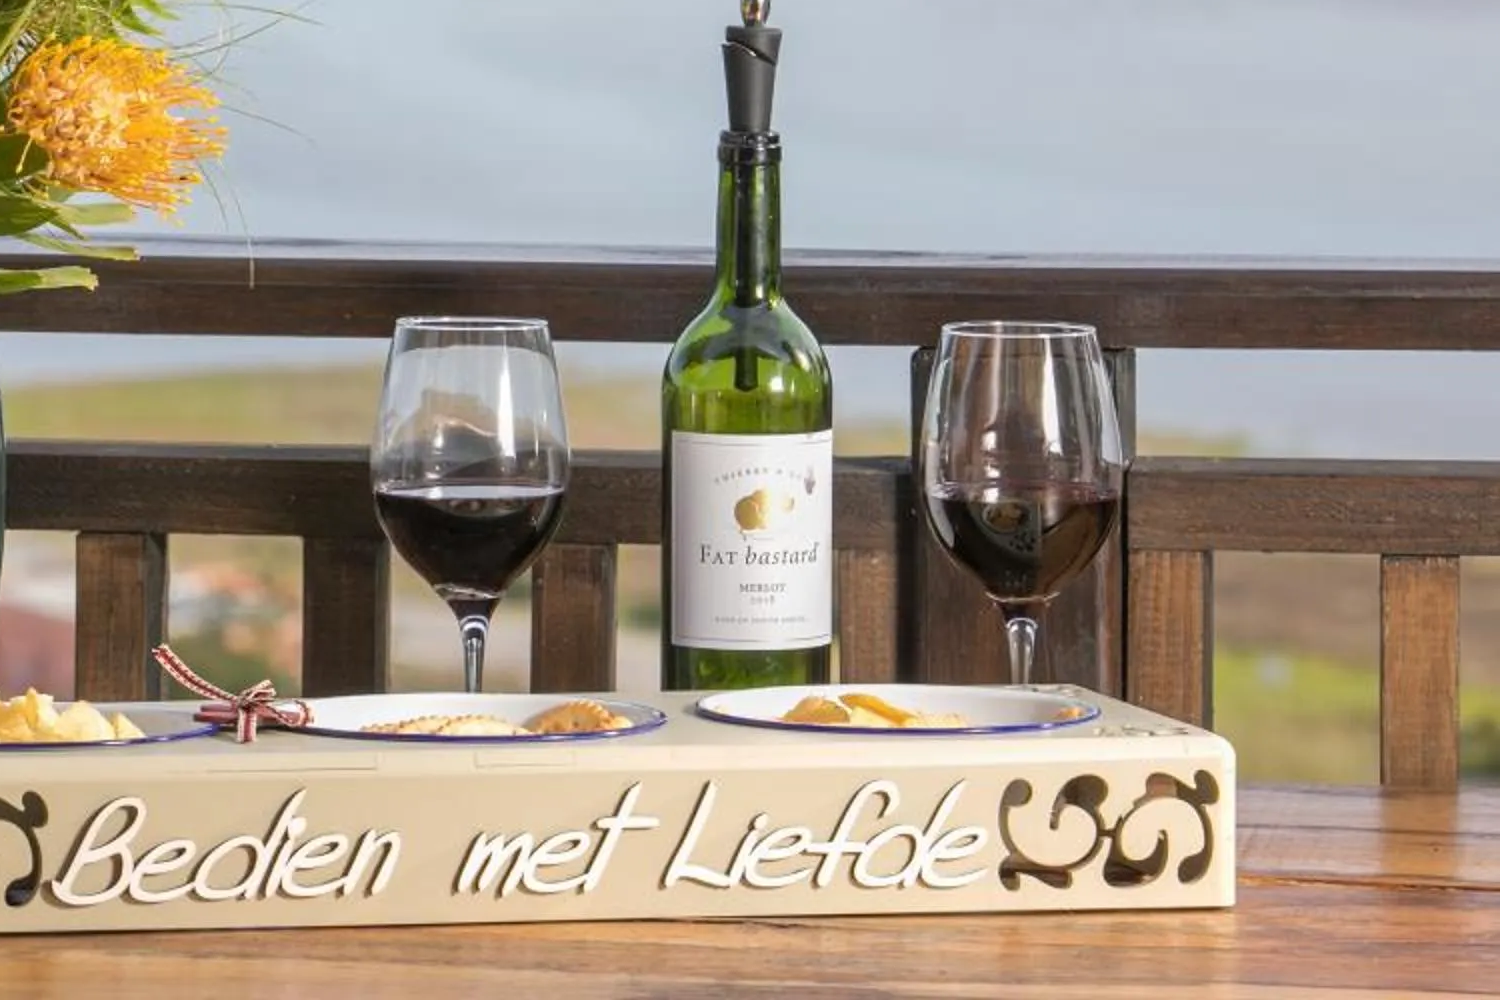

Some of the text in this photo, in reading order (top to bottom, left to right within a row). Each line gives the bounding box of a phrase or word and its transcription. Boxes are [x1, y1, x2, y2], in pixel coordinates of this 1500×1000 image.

[700, 541, 819, 565] FAT bastard
[739, 583, 786, 593] MERLOT
[50, 778, 988, 906] Bedien met Liefde
